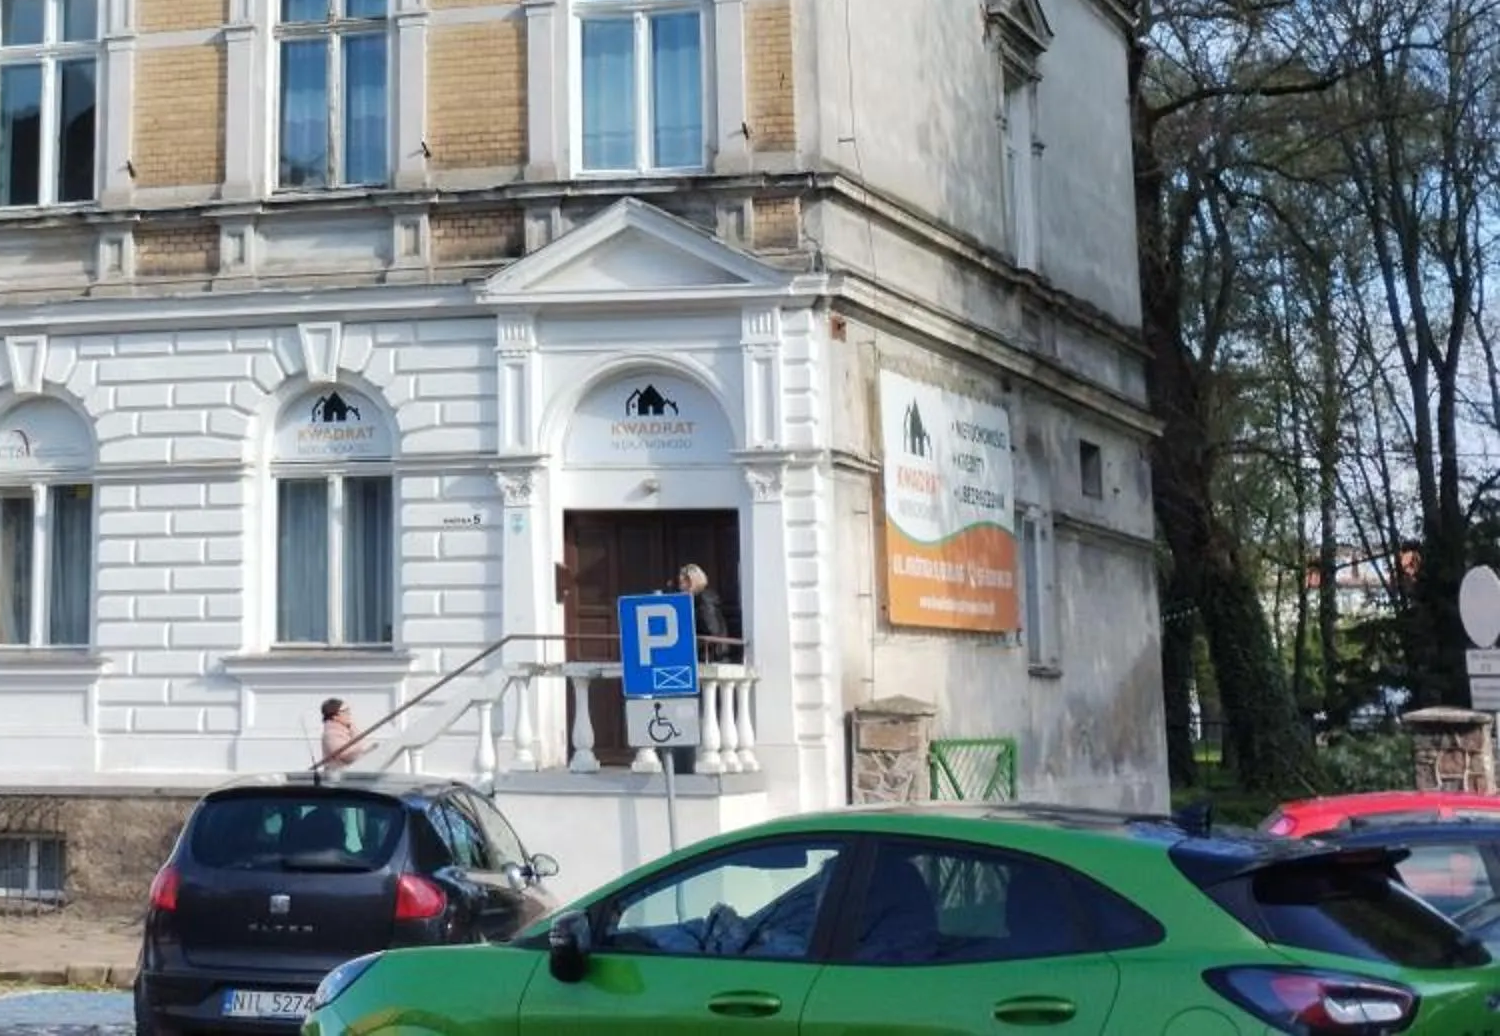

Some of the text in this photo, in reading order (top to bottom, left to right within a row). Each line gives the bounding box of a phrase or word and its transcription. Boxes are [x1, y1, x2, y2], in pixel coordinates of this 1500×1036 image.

[298, 425, 375, 442] KWADRAT
[611, 422, 695, 435] KWADRAT
[636, 604, 679, 666] P
